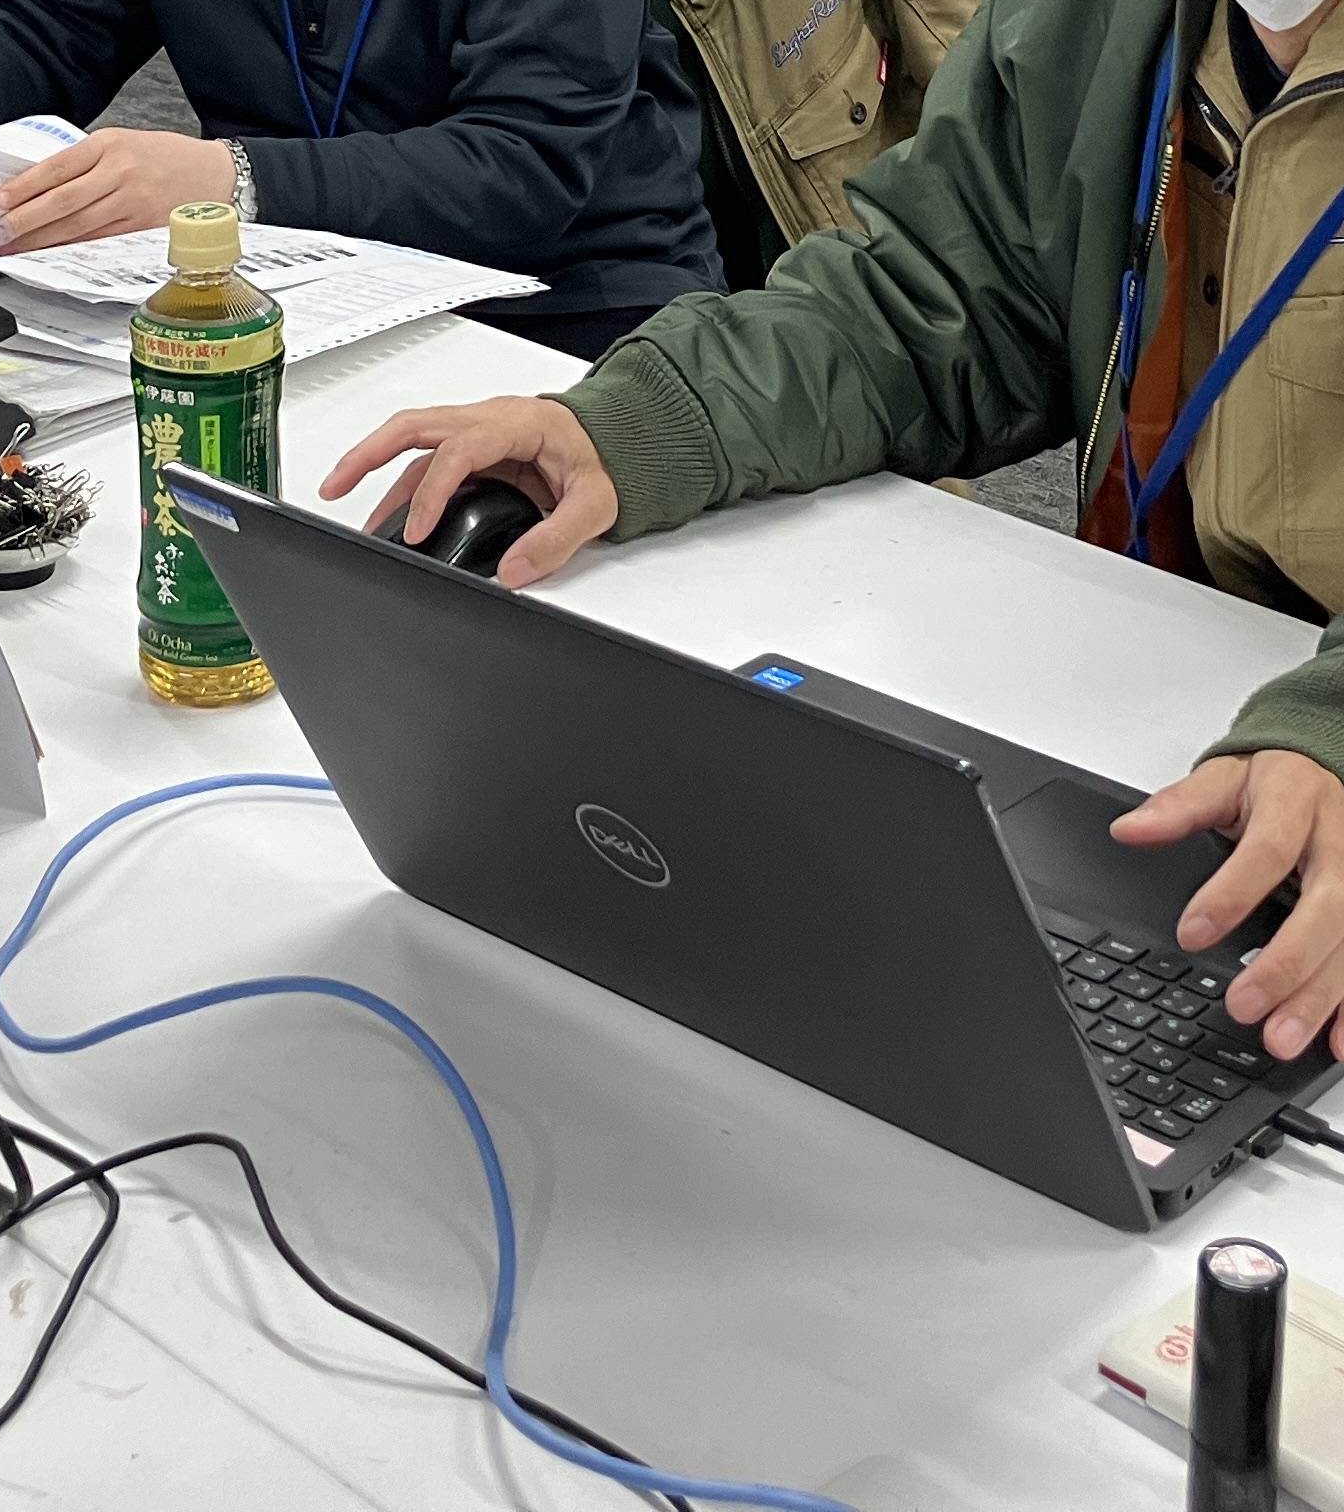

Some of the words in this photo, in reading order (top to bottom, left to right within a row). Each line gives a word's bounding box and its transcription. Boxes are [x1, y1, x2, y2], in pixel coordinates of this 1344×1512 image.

[145, 384, 195, 406] 伊藤園
[160, 633, 192, 652] Ocha
[588, 824, 663, 869] DELL
